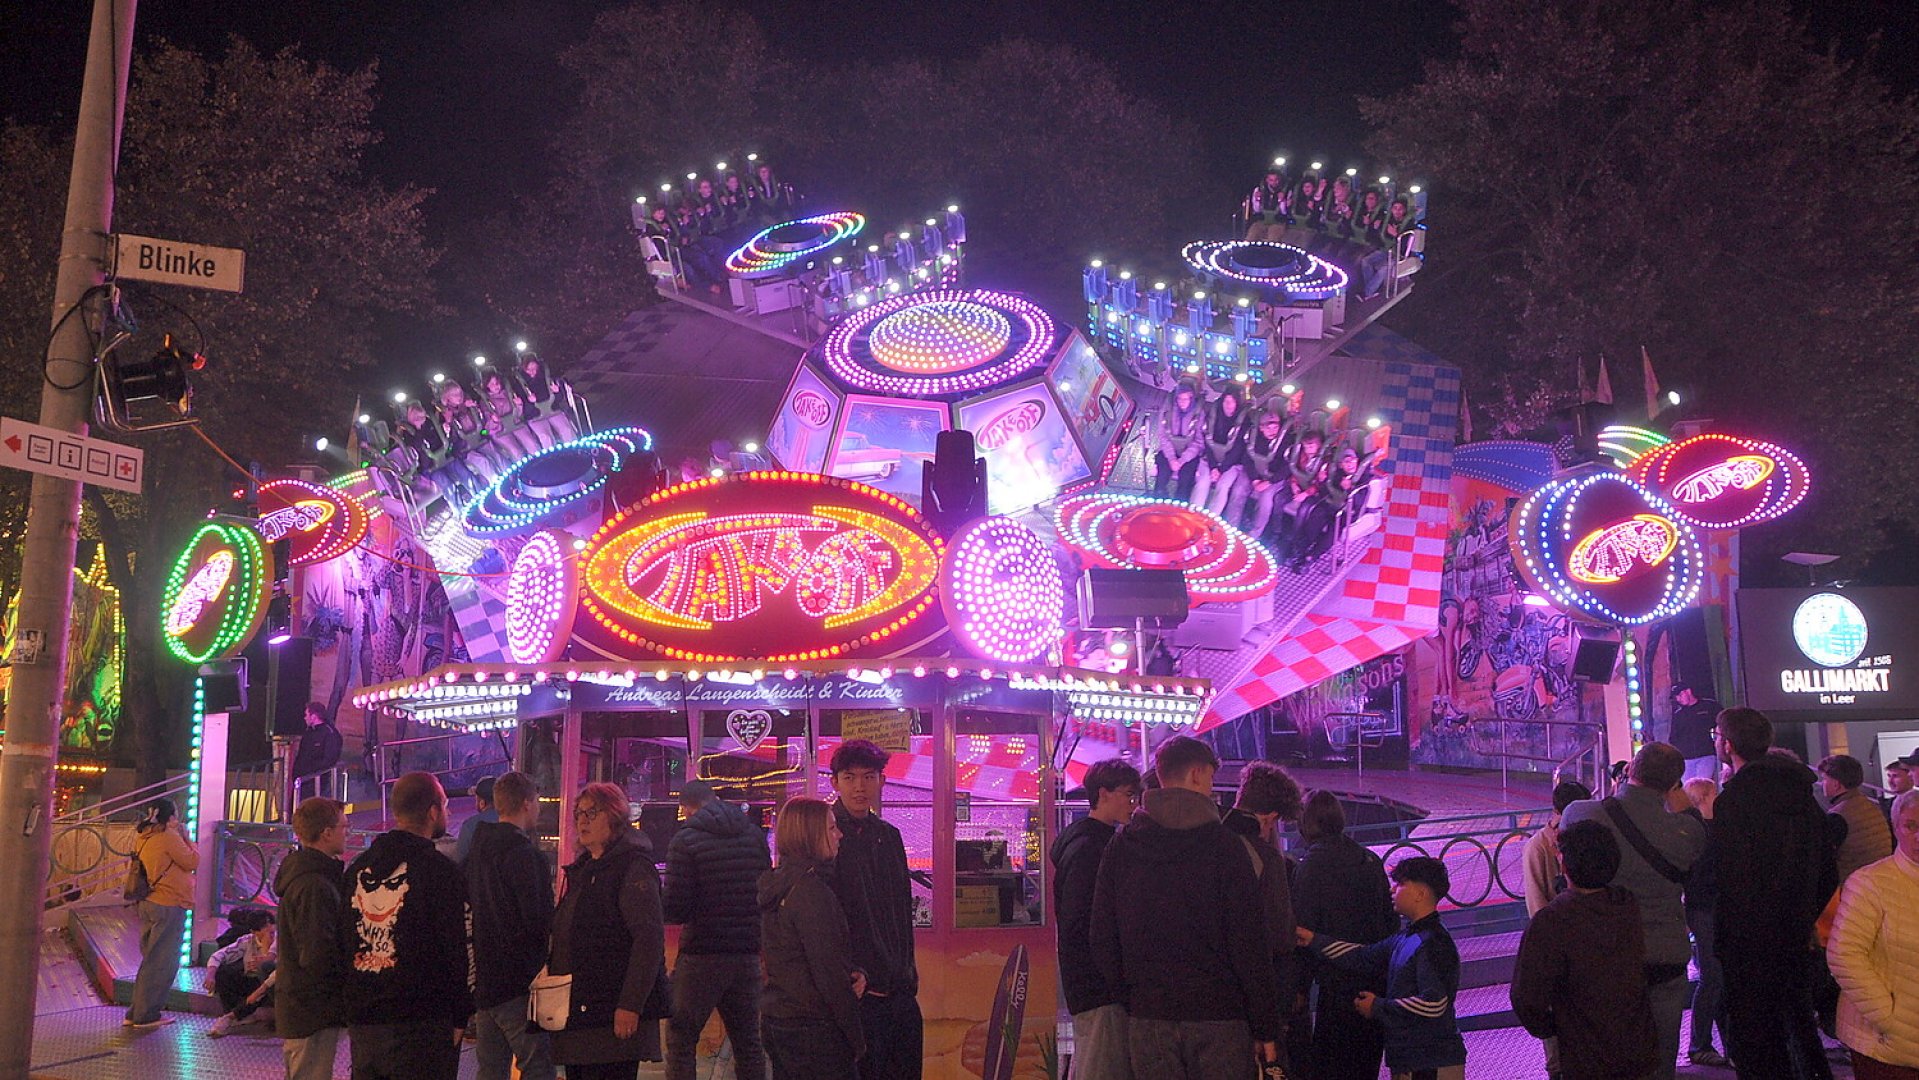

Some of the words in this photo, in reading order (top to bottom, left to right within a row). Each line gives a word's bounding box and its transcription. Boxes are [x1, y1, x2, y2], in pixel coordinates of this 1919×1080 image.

[139, 244, 216, 277] Blinke
[626, 513, 838, 622] TAKE
[796, 529, 892, 617] OFF
[605, 683, 682, 702] Andreas
[685, 683, 814, 705] Langenscheidt
[818, 681, 832, 699] &
[839, 681, 903, 700] Kinder
[1781, 668, 1890, 692] GALLIMARKT
[1820, 693, 1831, 704] in
[1833, 694, 1855, 704] Leer
[1011, 970, 1028, 1009] Kelly
